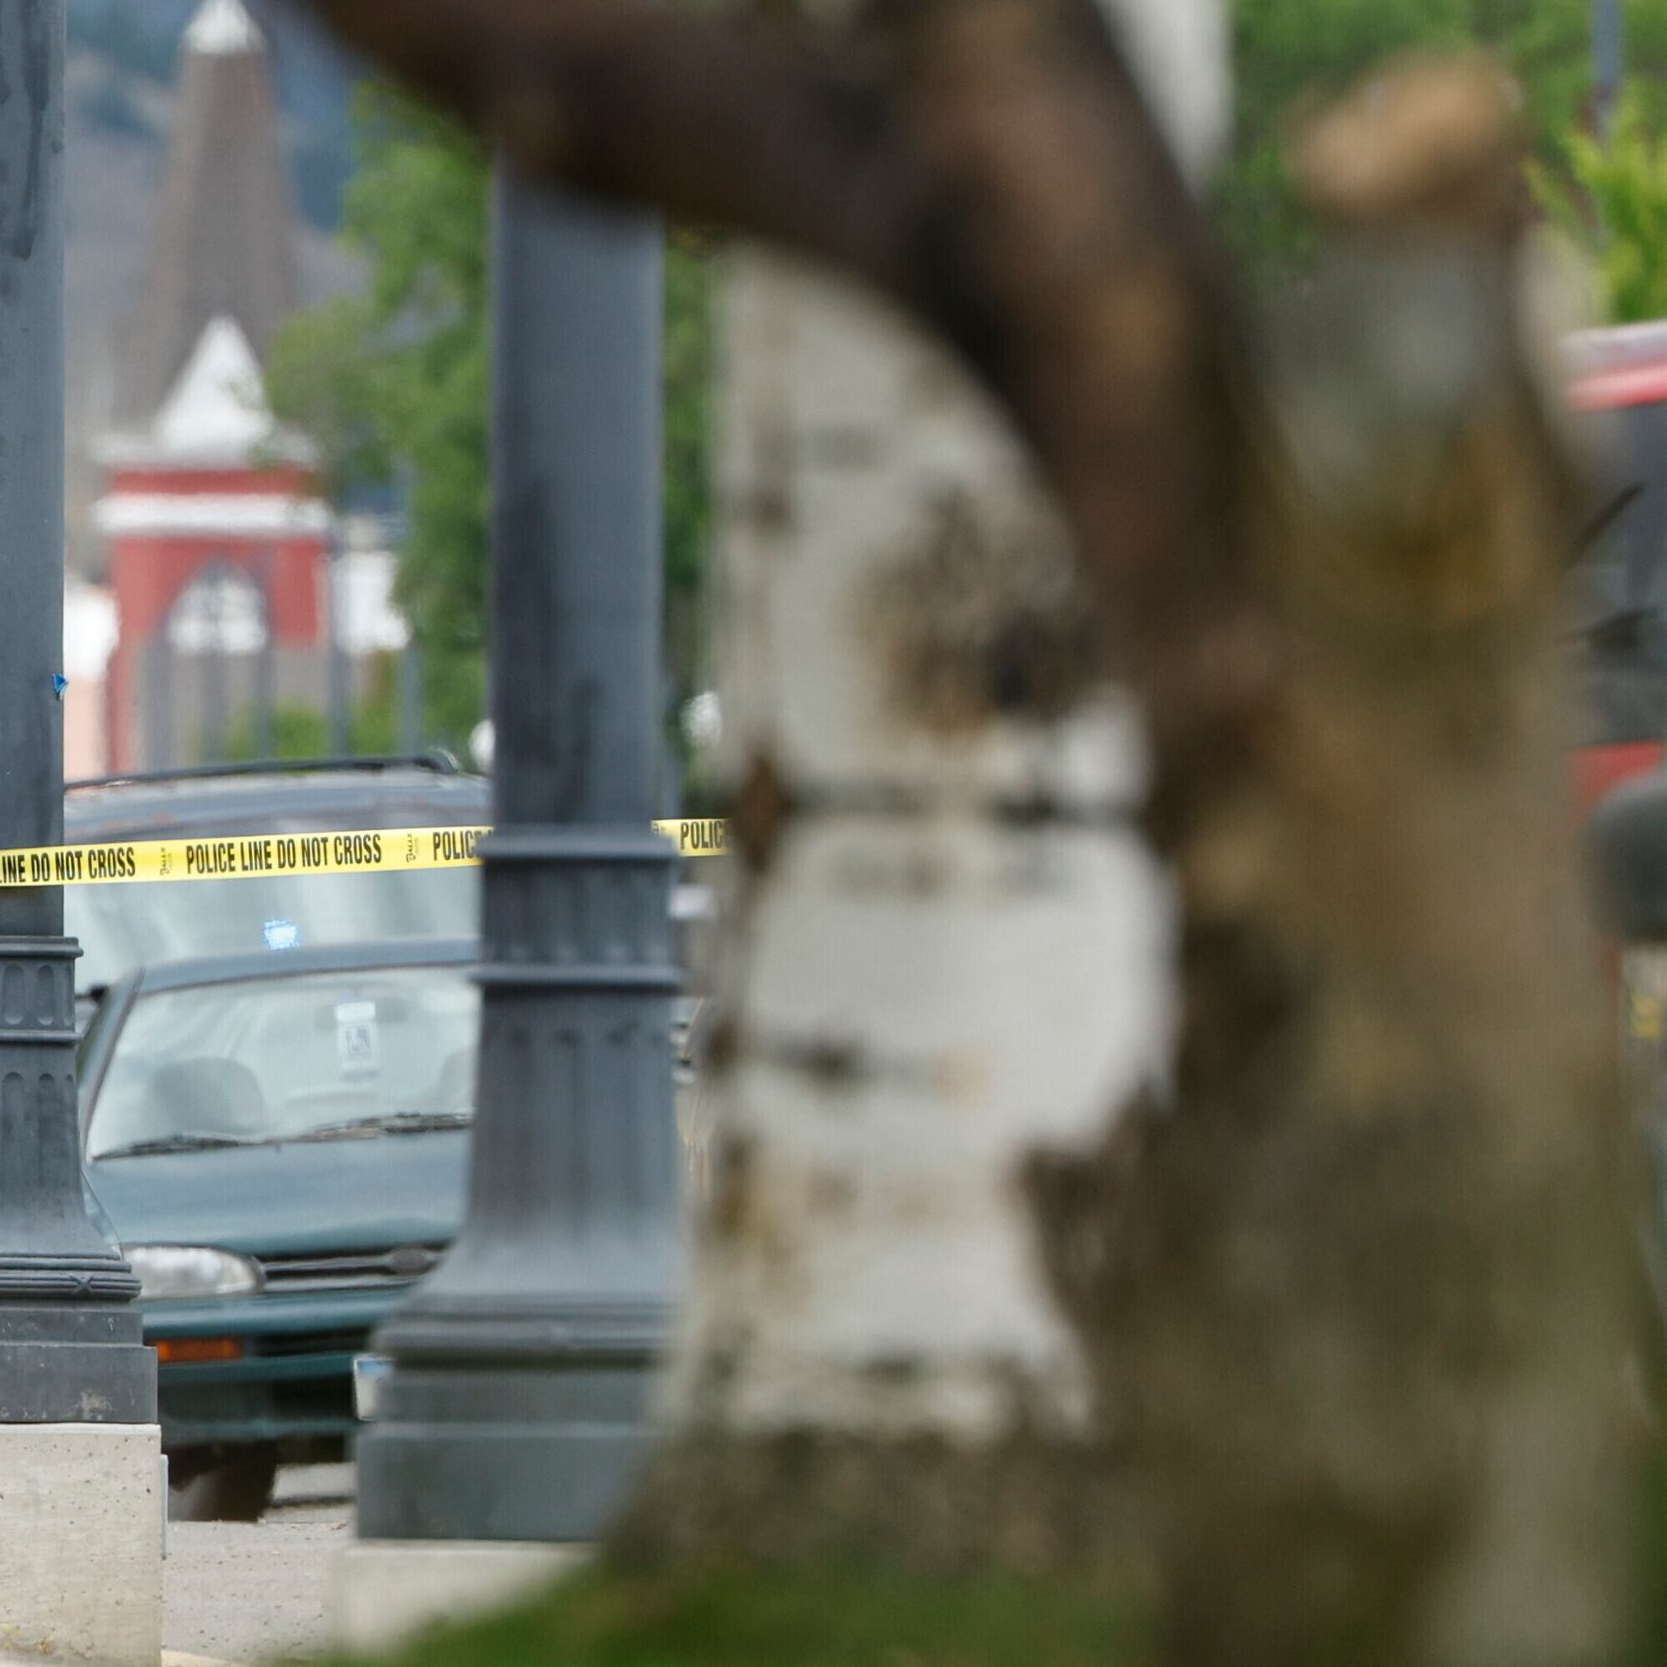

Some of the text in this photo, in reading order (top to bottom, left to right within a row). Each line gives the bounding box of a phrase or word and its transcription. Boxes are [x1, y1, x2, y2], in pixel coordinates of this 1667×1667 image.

[680, 820, 727, 850] POLIC
[31, 852, 50, 882] DO
[55, 850, 83, 881] NOT
[87, 847, 136, 879] CROSS
[186, 842, 235, 874] POLICE
[240, 840, 272, 871] LINE
[277, 838, 296, 869] DO
[301, 837, 329, 868] NOT
[333, 834, 382, 866] CROSS
